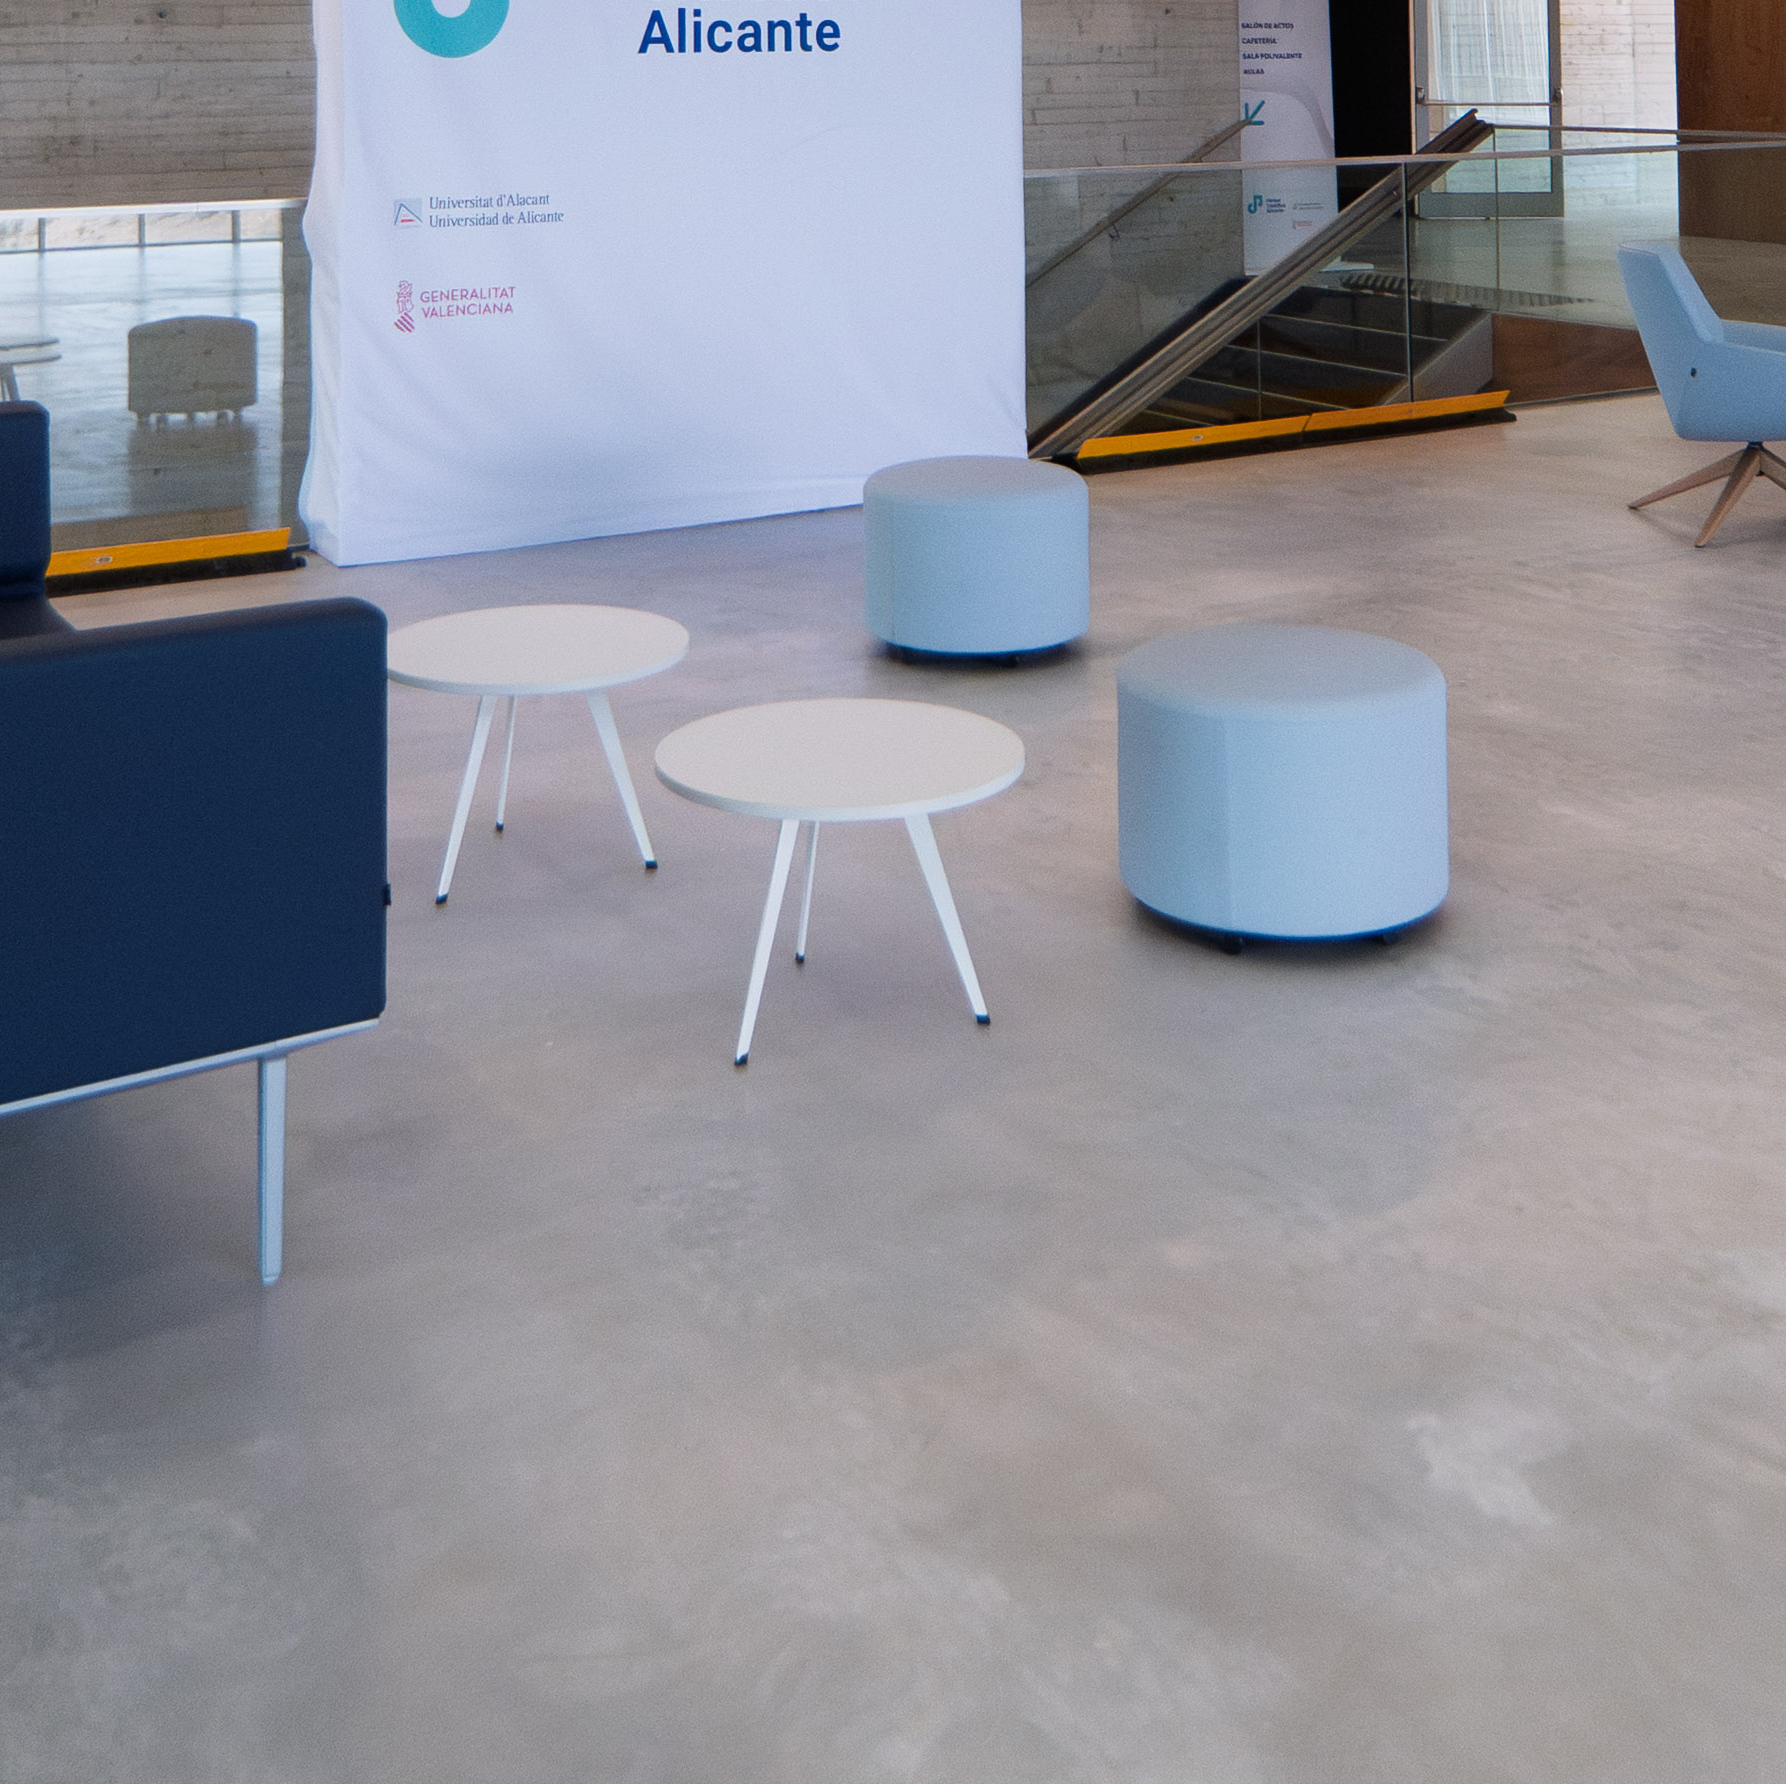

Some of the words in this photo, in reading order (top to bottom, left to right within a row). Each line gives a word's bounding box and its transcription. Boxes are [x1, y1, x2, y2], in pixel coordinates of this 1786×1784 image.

[637, 7, 842, 54] Alicante
[429, 195, 494, 211] Universitat
[496, 192, 550, 208] d'Alacant
[429, 212, 499, 228] Universidad
[502, 211, 514, 225] de
[517, 210, 565, 225] Alicante
[419, 286, 516, 304] GENERALITAT
[421, 302, 514, 320] VALENCIANA
